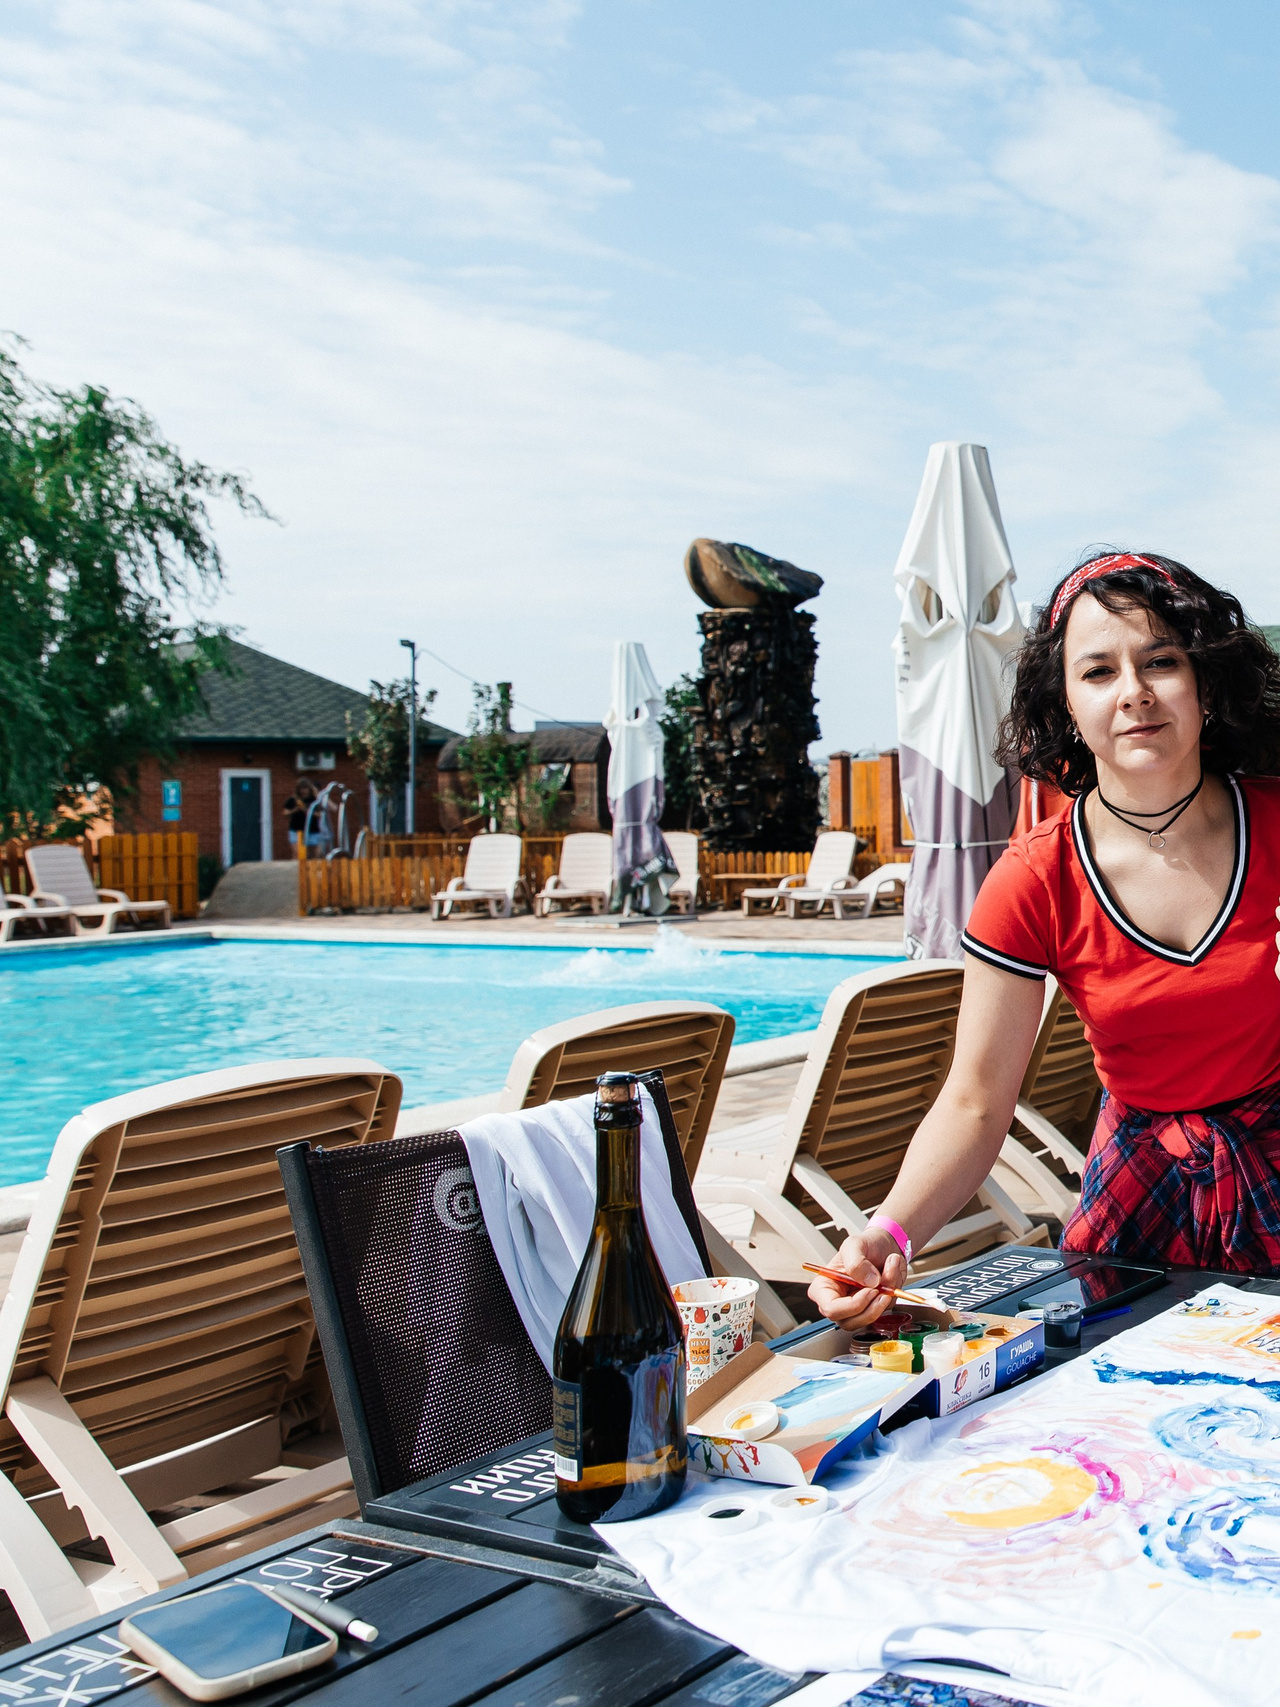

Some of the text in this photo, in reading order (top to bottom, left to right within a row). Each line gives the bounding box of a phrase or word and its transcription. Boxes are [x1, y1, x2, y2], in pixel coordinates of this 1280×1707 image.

[1010, 1339, 1034, 1360] ГУАШЬ
[978, 1361, 990, 1380] 16
[1006, 1351, 1037, 1375] GOUACHE
